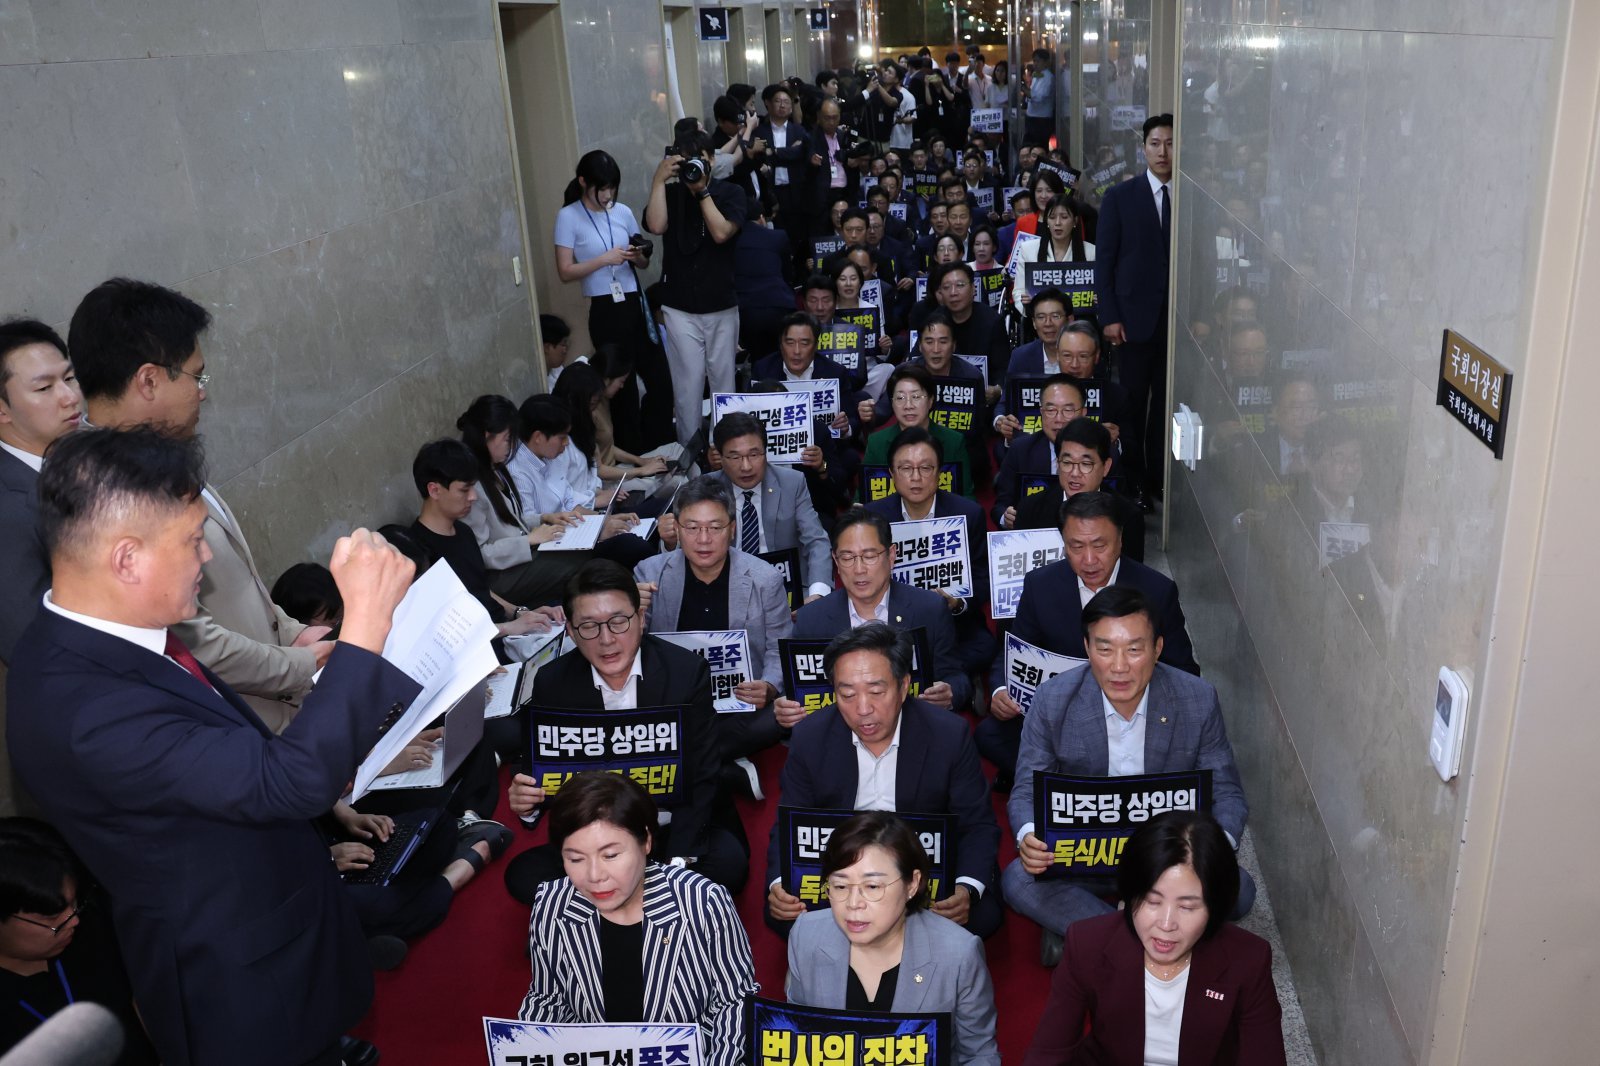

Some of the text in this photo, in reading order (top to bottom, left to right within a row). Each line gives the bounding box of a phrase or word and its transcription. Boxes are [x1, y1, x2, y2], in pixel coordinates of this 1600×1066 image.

[815, 241, 836, 254] 민주당
[1032, 269, 1094, 286] 민주당 상임위
[862, 287, 877, 302] 폭주
[1071, 290, 1095, 308] 중단!
[835, 331, 858, 349] 집착
[1451, 344, 1502, 410] 국회의장실
[813, 388, 835, 410] 폭주
[942, 385, 974, 405] 상임위
[1085, 388, 1100, 408] 위
[783, 402, 807, 427] 폭주
[948, 411, 973, 430] 중단!
[1448, 390, 1494, 442] 국회의장비서실
[767, 430, 808, 456] 국민협박
[931, 529, 961, 556] 폭주
[913, 560, 963, 590] 국민협박
[998, 552, 1027, 579] 국회
[708, 643, 741, 669] 폭주
[1011, 658, 1044, 688] 국회
[537, 721, 678, 758] 민주당 상임위
[1051, 791, 1122, 824] 민주당
[914, 831, 941, 865] 위
[1053, 836, 1130, 868] 독식시
